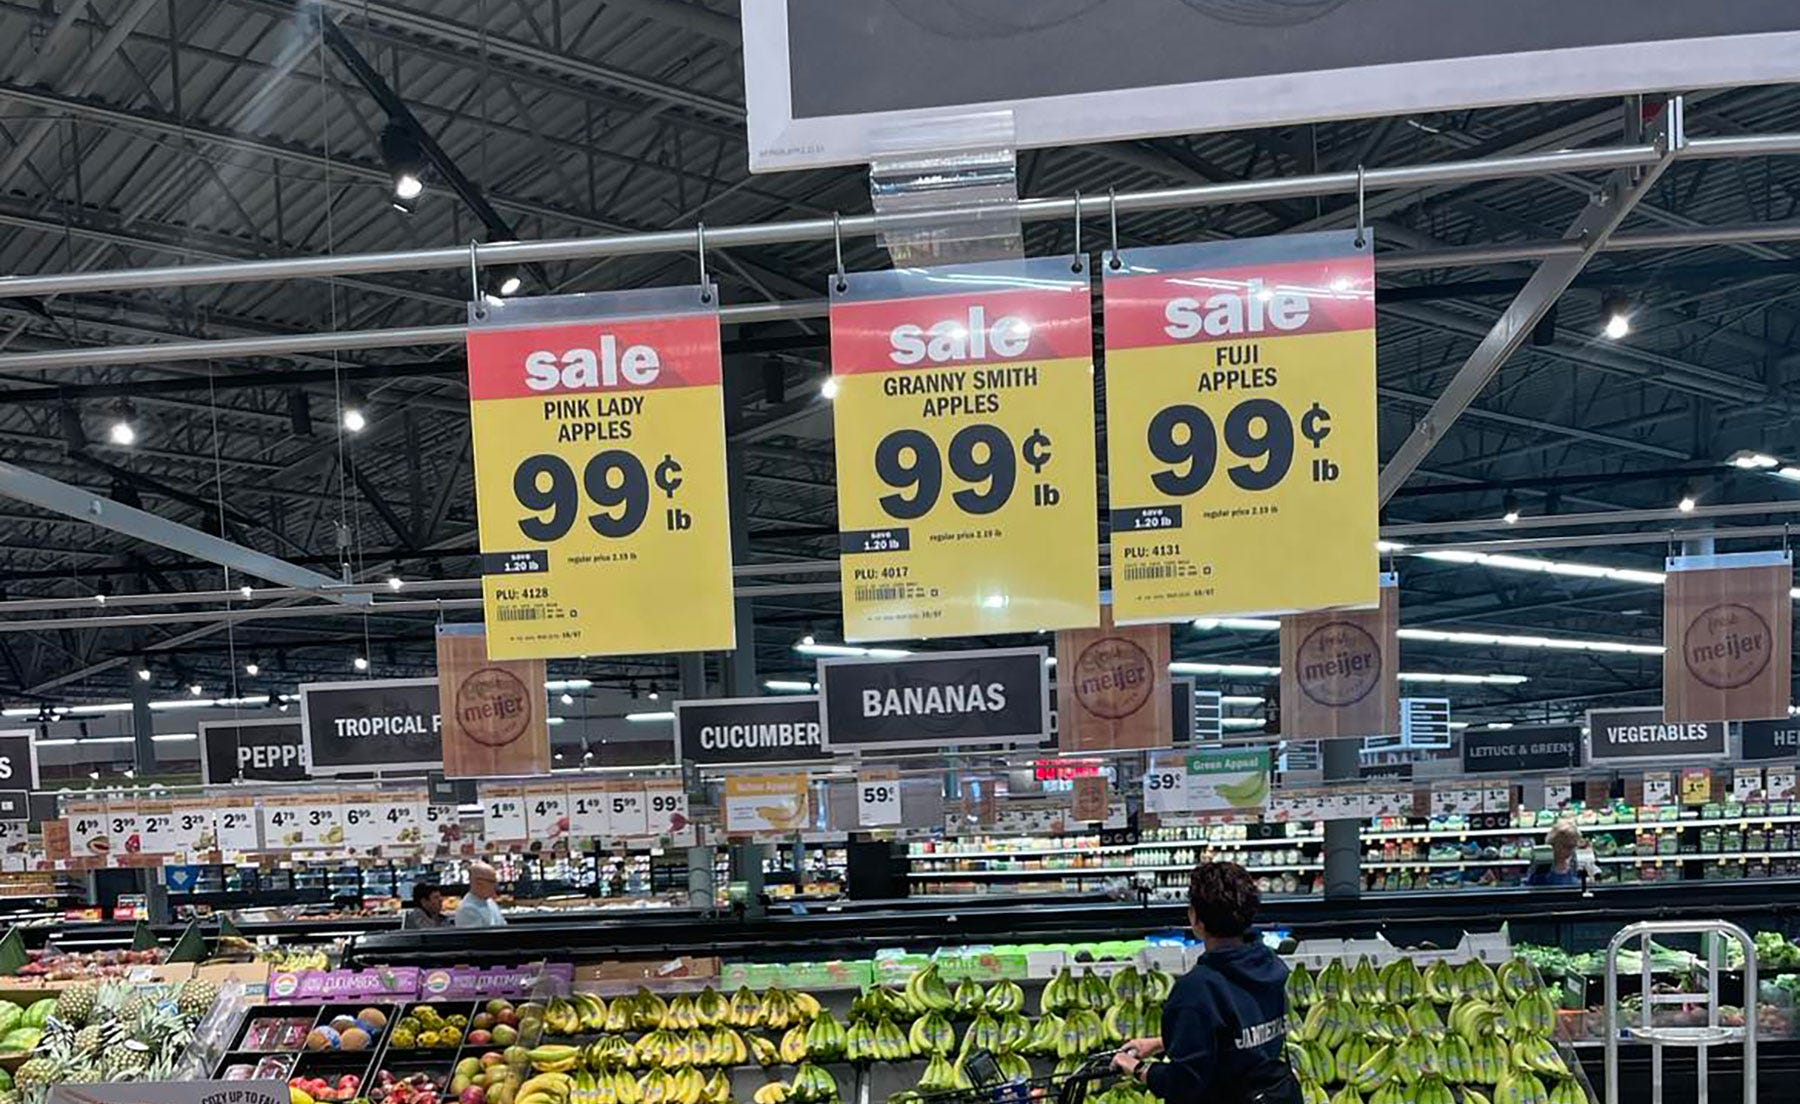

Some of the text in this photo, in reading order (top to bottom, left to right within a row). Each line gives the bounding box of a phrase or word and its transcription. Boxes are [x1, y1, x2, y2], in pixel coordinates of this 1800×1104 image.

[1164, 278, 1311, 339] sale
[888, 305, 1032, 364] sale
[524, 334, 660, 391] sale
[1216, 345, 1259, 366] FUJI
[884, 367, 1038, 396] GRANNY SMITH
[1198, 367, 1278, 392] APPLES
[544, 396, 645, 420] PINK LADY
[922, 394, 1000, 418] APPLES
[558, 420, 632, 443] APPLES
[1312, 459, 1339, 482] lb
[1034, 484, 1060, 507] lb
[667, 509, 691, 531] lb
[1134, 517, 1172, 528] 1.20 lb
[864, 540, 899, 550] 1.20 lb
[1124, 544, 1180, 558] PLU: 4131
[504, 561, 539, 572] 1.20 lb
[854, 567, 908, 580] PLU: 4017
[495, 587, 548, 601] PLU: 4128
[1693, 632, 1763, 663] meijer
[1305, 651, 1372, 680] meijer
[1081, 666, 1145, 695] meijer
[464, 695, 523, 722] meijer
[862, 683, 1007, 718] BANANAS
[334, 715, 427, 738] TROPICAL
[700, 722, 821, 750] CUCUMBER
[1607, 724, 1708, 744] VEGETABLES
[1773, 730, 1800, 746] HE
[1470, 742, 1575, 758] LETTUCE & GREENS
[229, 1091, 243, 1103] UP
[245, 1091, 258, 1104] TO
